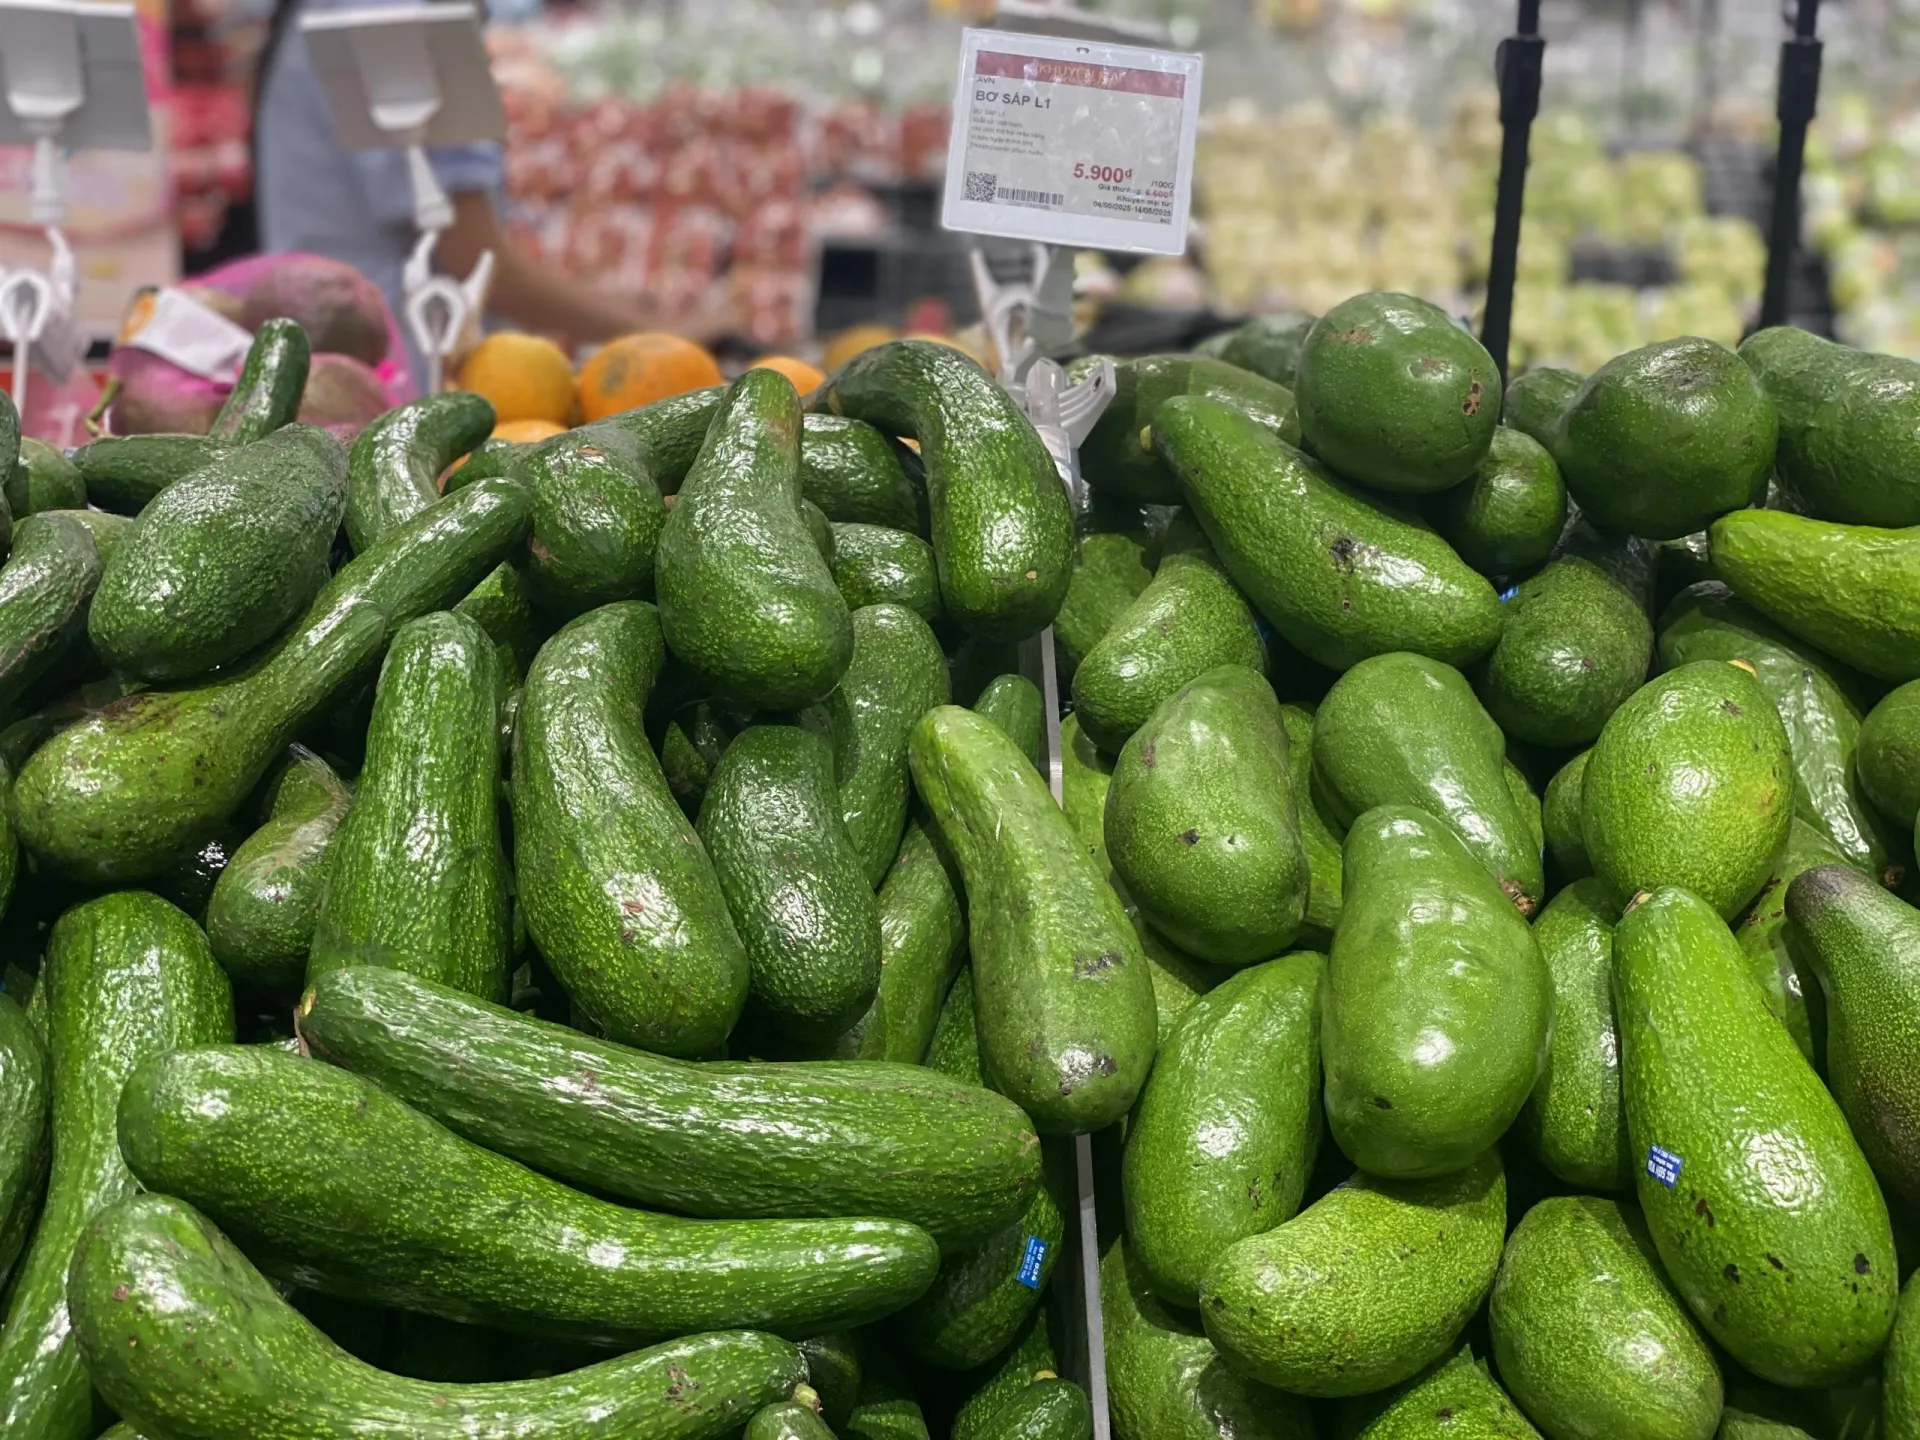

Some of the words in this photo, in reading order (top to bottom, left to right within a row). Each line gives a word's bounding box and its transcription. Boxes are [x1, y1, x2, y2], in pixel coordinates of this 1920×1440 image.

[975, 90, 999, 102] BƠ
[1002, 92, 1031, 106] SÁP
[1035, 97, 1051, 109] L1
